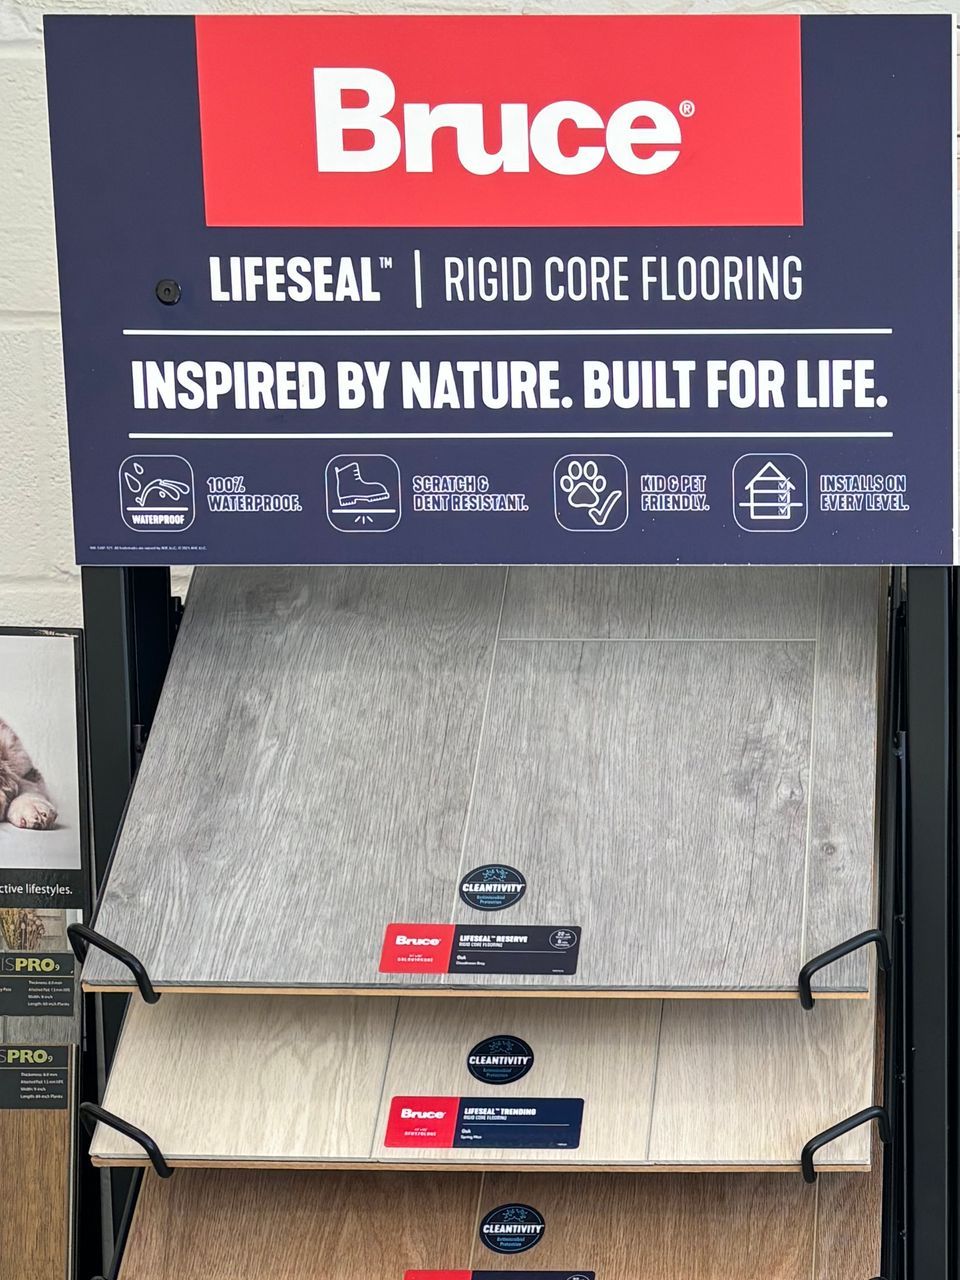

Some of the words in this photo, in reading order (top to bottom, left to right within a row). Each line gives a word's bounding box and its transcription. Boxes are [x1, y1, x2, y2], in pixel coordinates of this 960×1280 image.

[444, 256, 532, 301] RIGID
[545, 256, 629, 301] CORE
[642, 256, 802, 301] FLOORING
[131, 360, 326, 410] INSPIRED
[337, 361, 391, 409] BY
[402, 361, 573, 409] NATURE.
[583, 360, 696, 409] BUILT
[707, 360, 785, 408] FOR
[797, 359, 889, 408] LIFE.
[207, 476, 246, 493] 100%
[412, 475, 476, 493] SCRATCH
[640, 475, 667, 493] KID
[680, 475, 707, 493] PET
[820, 475, 881, 492] INSTALLS
[884, 475, 907, 492] ON
[208, 494, 303, 513] WATERPROOF.
[413, 494, 449, 512] DENT
[450, 494, 530, 512] RESISTANT.
[641, 494, 711, 512] FRIENDLY.
[820, 494, 864, 511] EVERY
[865, 494, 910, 511] LEVEL.
[131, 514, 185, 526] WATERPROOF
[25, 883, 73, 897] lifestyles.
[396, 936, 441, 946] Bruce
[401, 1109, 446, 1119] Bruce
